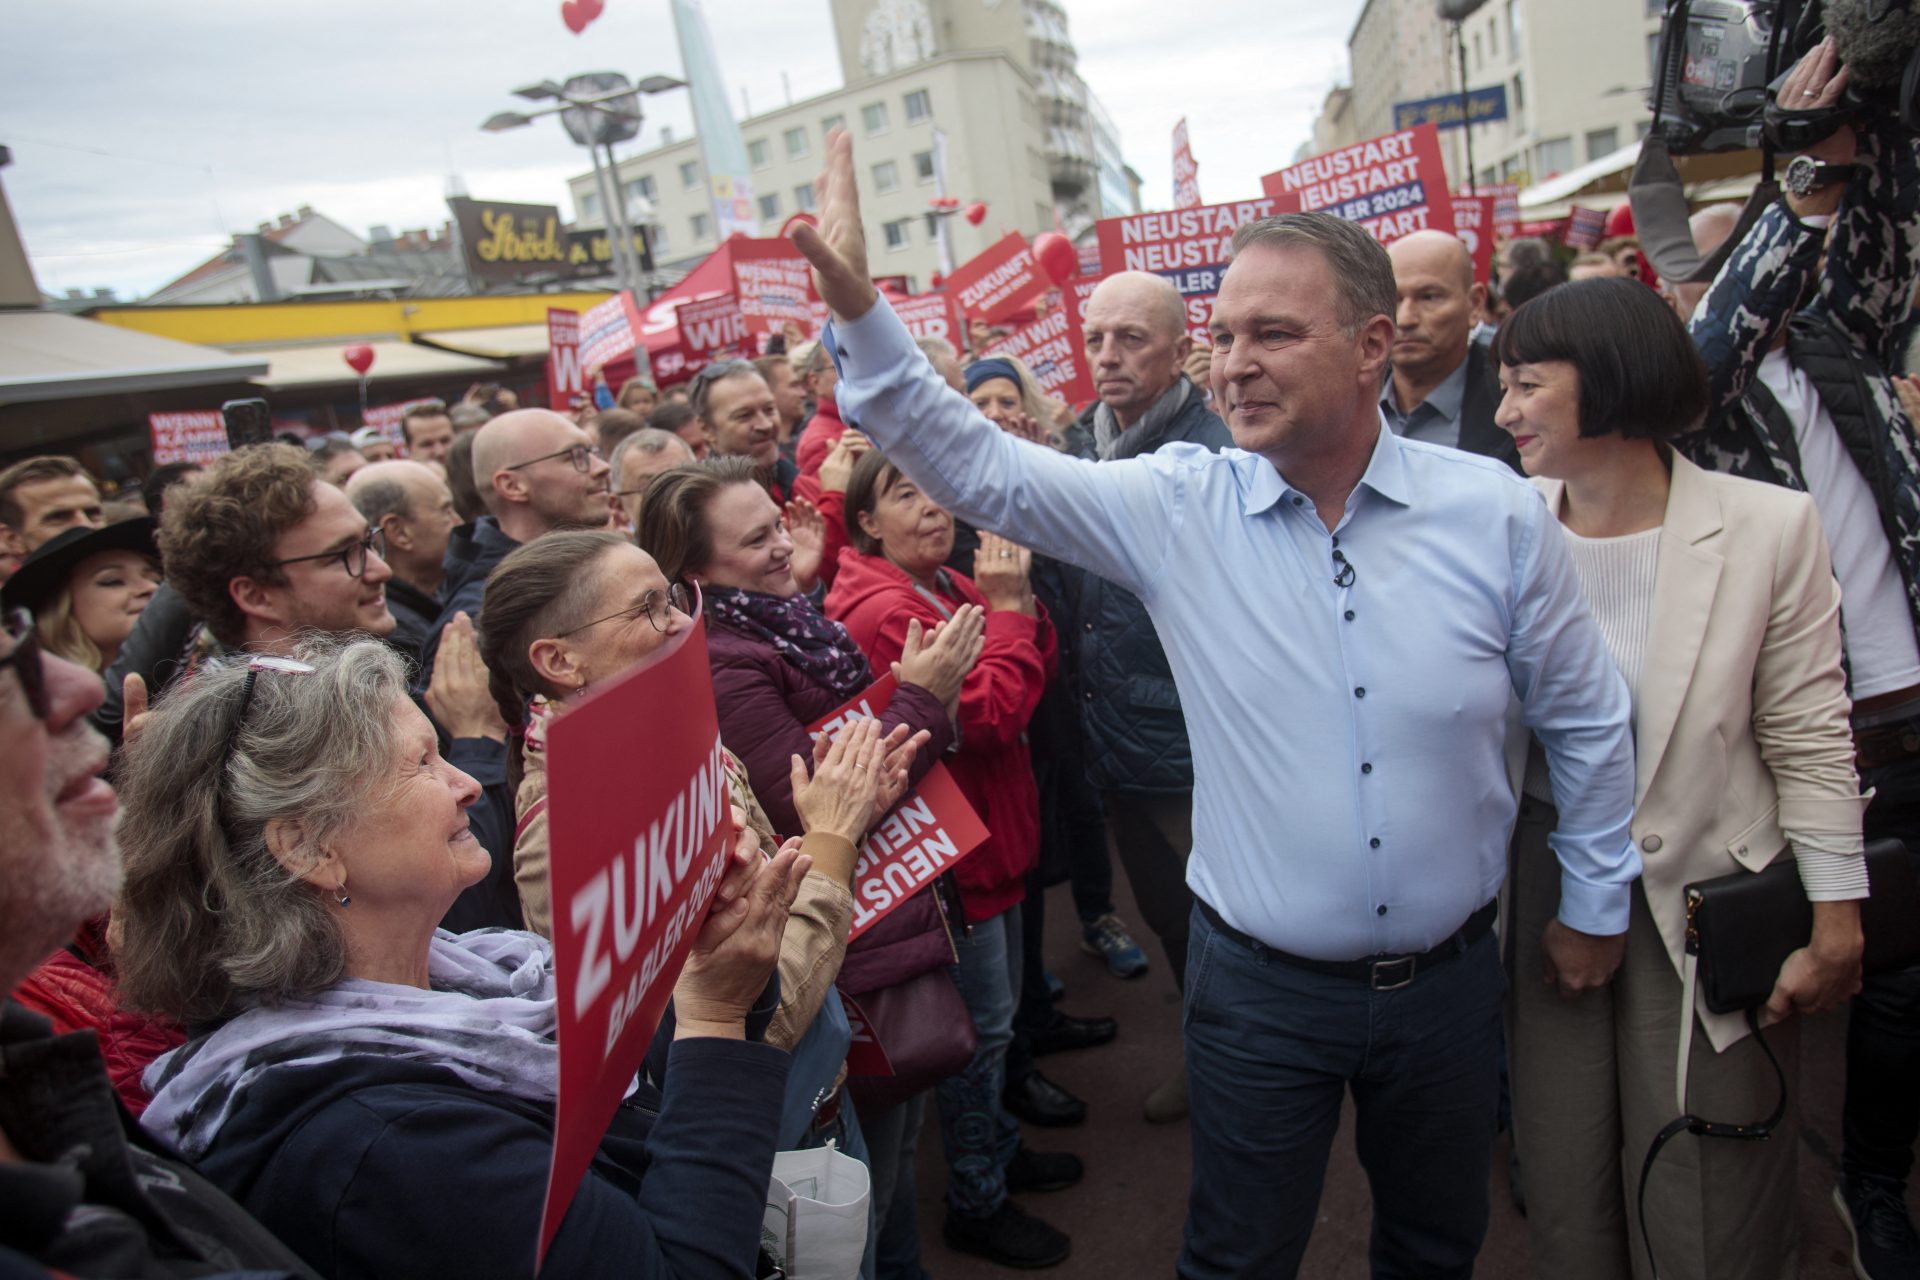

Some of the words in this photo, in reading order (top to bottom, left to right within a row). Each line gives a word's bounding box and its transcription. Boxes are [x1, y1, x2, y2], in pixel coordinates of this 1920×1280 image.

[1281, 131, 1415, 192] NEUSTART
[1330, 202, 1371, 221] LER
[1372, 184, 1424, 213] 2024
[1120, 200, 1275, 244] NEUSTART
[1361, 206, 1430, 241] TART
[1124, 237, 1236, 272] NEUSTA
[960, 249, 1033, 309] ZUKUNFT
[684, 312, 750, 351] WIR
[909, 318, 949, 339] IR
[1027, 312, 1070, 345] WIR
[1022, 336, 1073, 371] PFEN
[852, 828, 960, 930] NEUST
[603, 901, 687, 1060] BABLER
[685, 837, 728, 929] 2024
